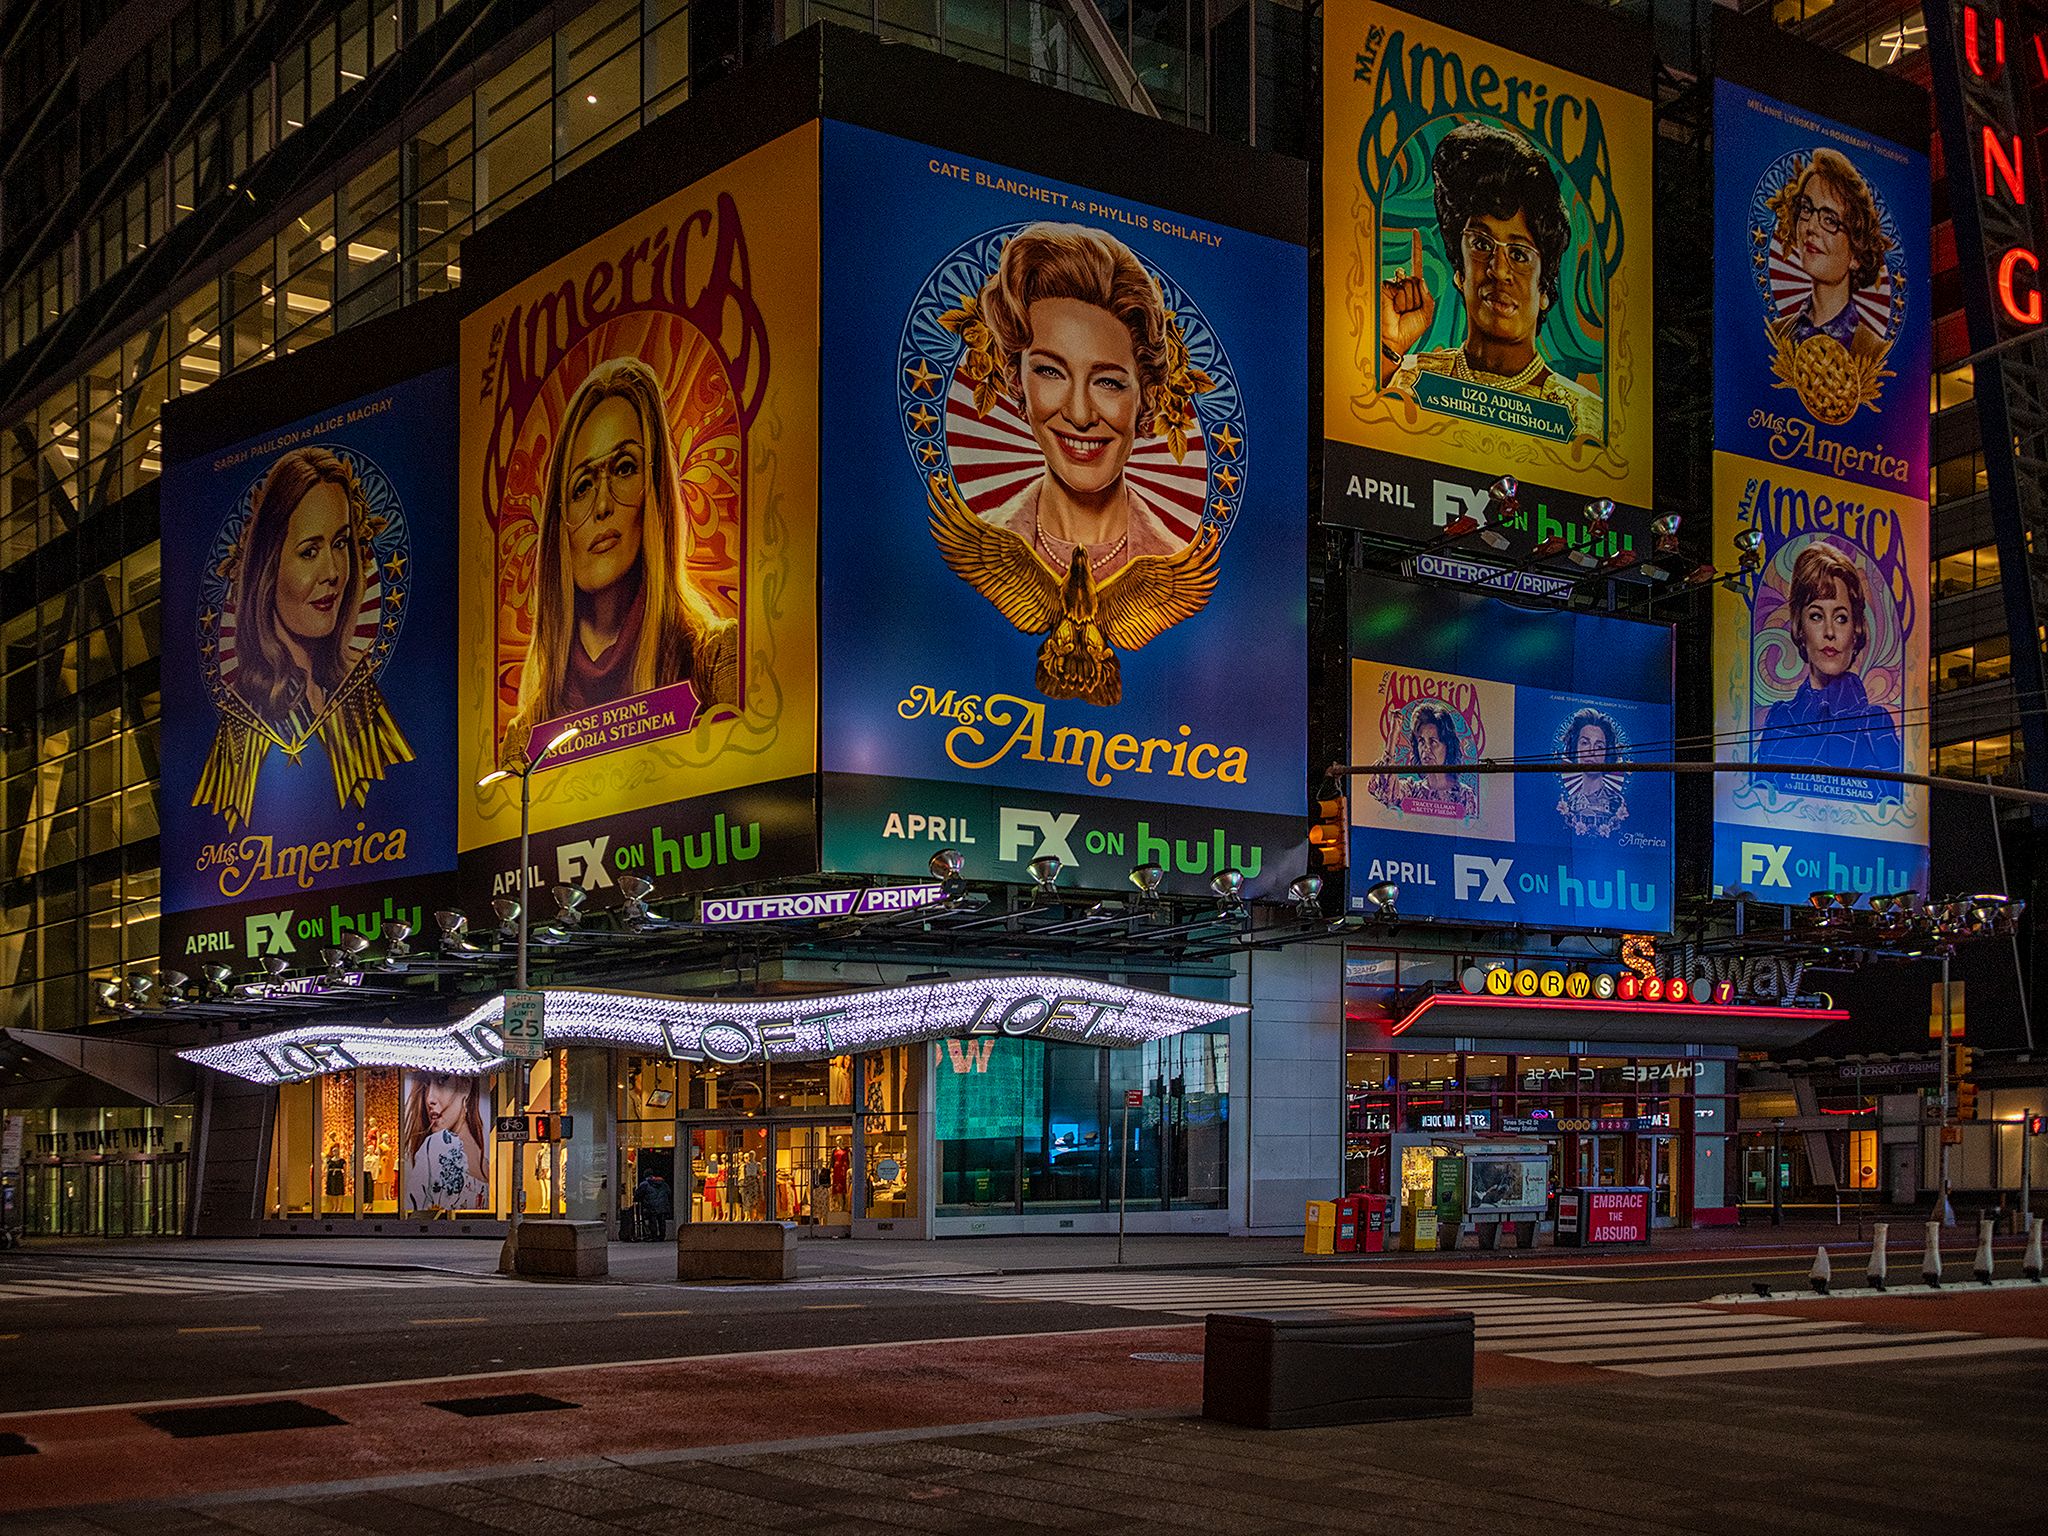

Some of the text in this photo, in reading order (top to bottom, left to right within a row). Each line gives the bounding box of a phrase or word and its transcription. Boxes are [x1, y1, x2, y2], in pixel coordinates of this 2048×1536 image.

[929, 159, 1222, 247] CATE BLANCHETT AS PHYLLIS SCHLAFLY
[1426, 395, 1564, 435] AS SHIRLEY CHISHOLM
[1461, 387, 1533, 415] UZO ADUBA
[251, 431, 300, 458] PAULSON
[313, 415, 345, 436] ALICE
[347, 397, 393, 424] MACRAY
[1747, 408, 1909, 483] Mrs. America
[1346, 474, 1416, 508] APRIL
[1433, 479, 1491, 529] FX
[1421, 556, 1568, 597] OUTFRONT PRIME
[558, 729, 607, 756] GLORIA
[610, 711, 676, 741] STEINEM
[602, 700, 648, 726] BYRNE
[897, 684, 1249, 787] Mrs. America
[1790, 772, 1869, 790] ELIZABETH BANKS
[1793, 782, 1811, 792] JILL
[1813, 783, 1874, 800] RUCKELSHAUS
[196, 822, 407, 897] Mrs. America
[557, 835, 614, 892] FX
[615, 843, 645, 870] ON
[652, 813, 760, 877] hulu
[881, 806, 1262, 880] APRIL FX ON hulu
[1618, 833, 1667, 849] America
[1368, 854, 1655, 912] APRIL FX ON hulu
[1741, 841, 1908, 896] FX ON hulu
[706, 886, 942, 921] OUTFRONT PRIME
[185, 930, 235, 955] APRIL
[245, 909, 297, 958] FX
[297, 917, 324, 939] ON
[1621, 935, 1803, 1007] Subway
[509, 1018, 539, 1037] 25
[512, 1001, 536, 1009] SPEED
[966, 994, 1126, 1040] LOFT
[660, 1009, 846, 1064] LOFT
[256, 1040, 359, 1080] LOFT
[1593, 1194, 1643, 1209] EMBRACE
[1609, 1212, 1623, 1221] THE
[1594, 1226, 1638, 1241] ABSURD
